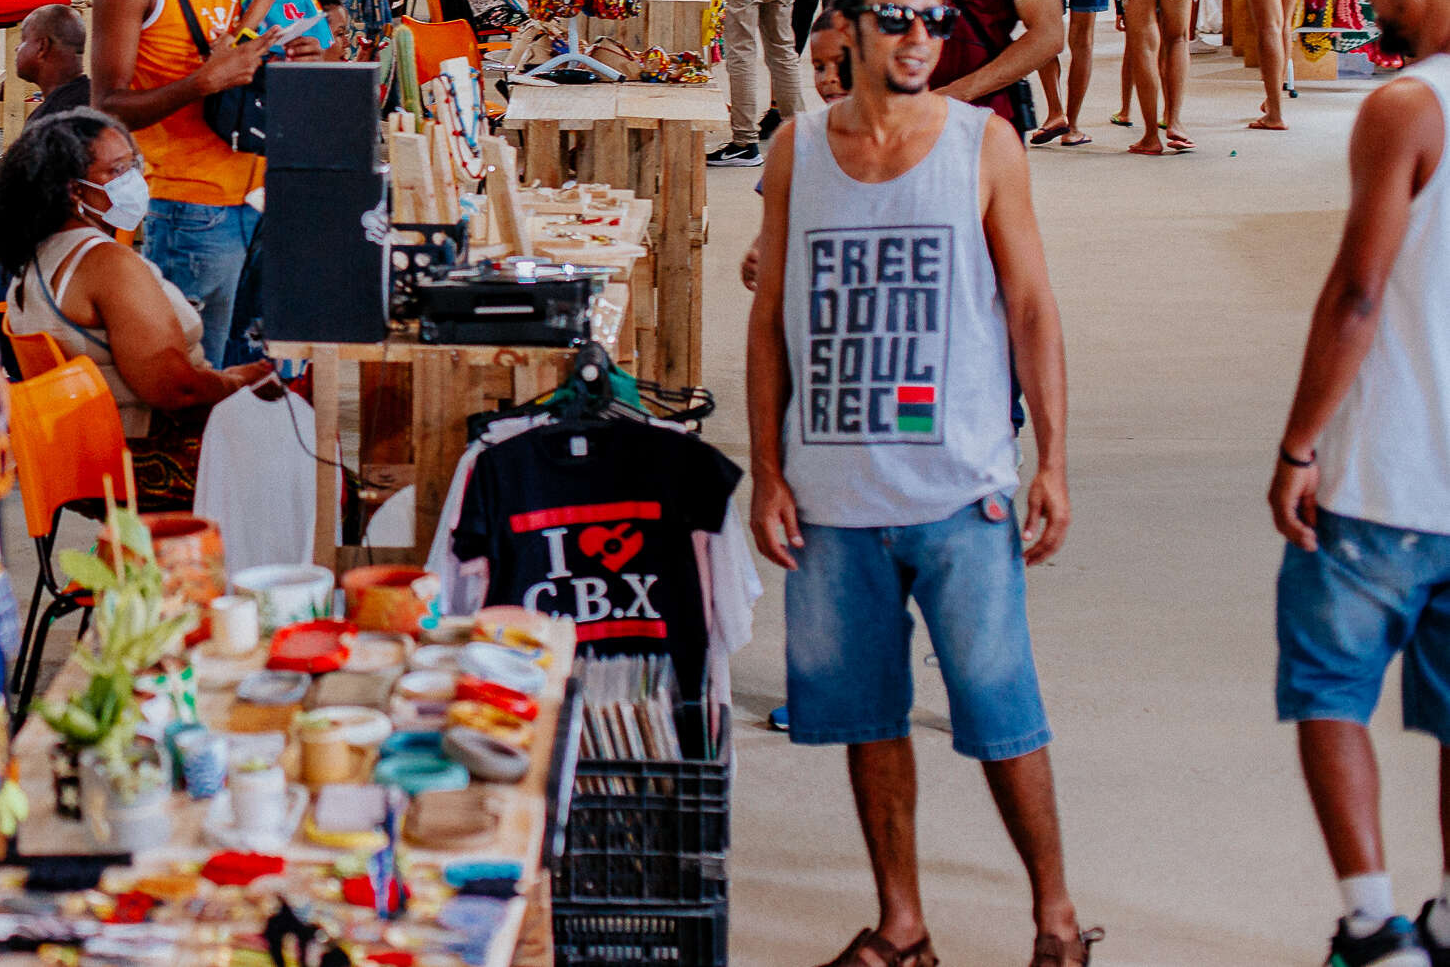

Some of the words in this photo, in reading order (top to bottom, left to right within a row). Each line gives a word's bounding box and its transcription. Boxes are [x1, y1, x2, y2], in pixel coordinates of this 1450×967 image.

[810, 238, 940, 287] FREE
[809, 287, 939, 334] DOM
[810, 337, 934, 384] SOUL
[810, 387, 894, 433] REC
[541, 528, 572, 579] I
